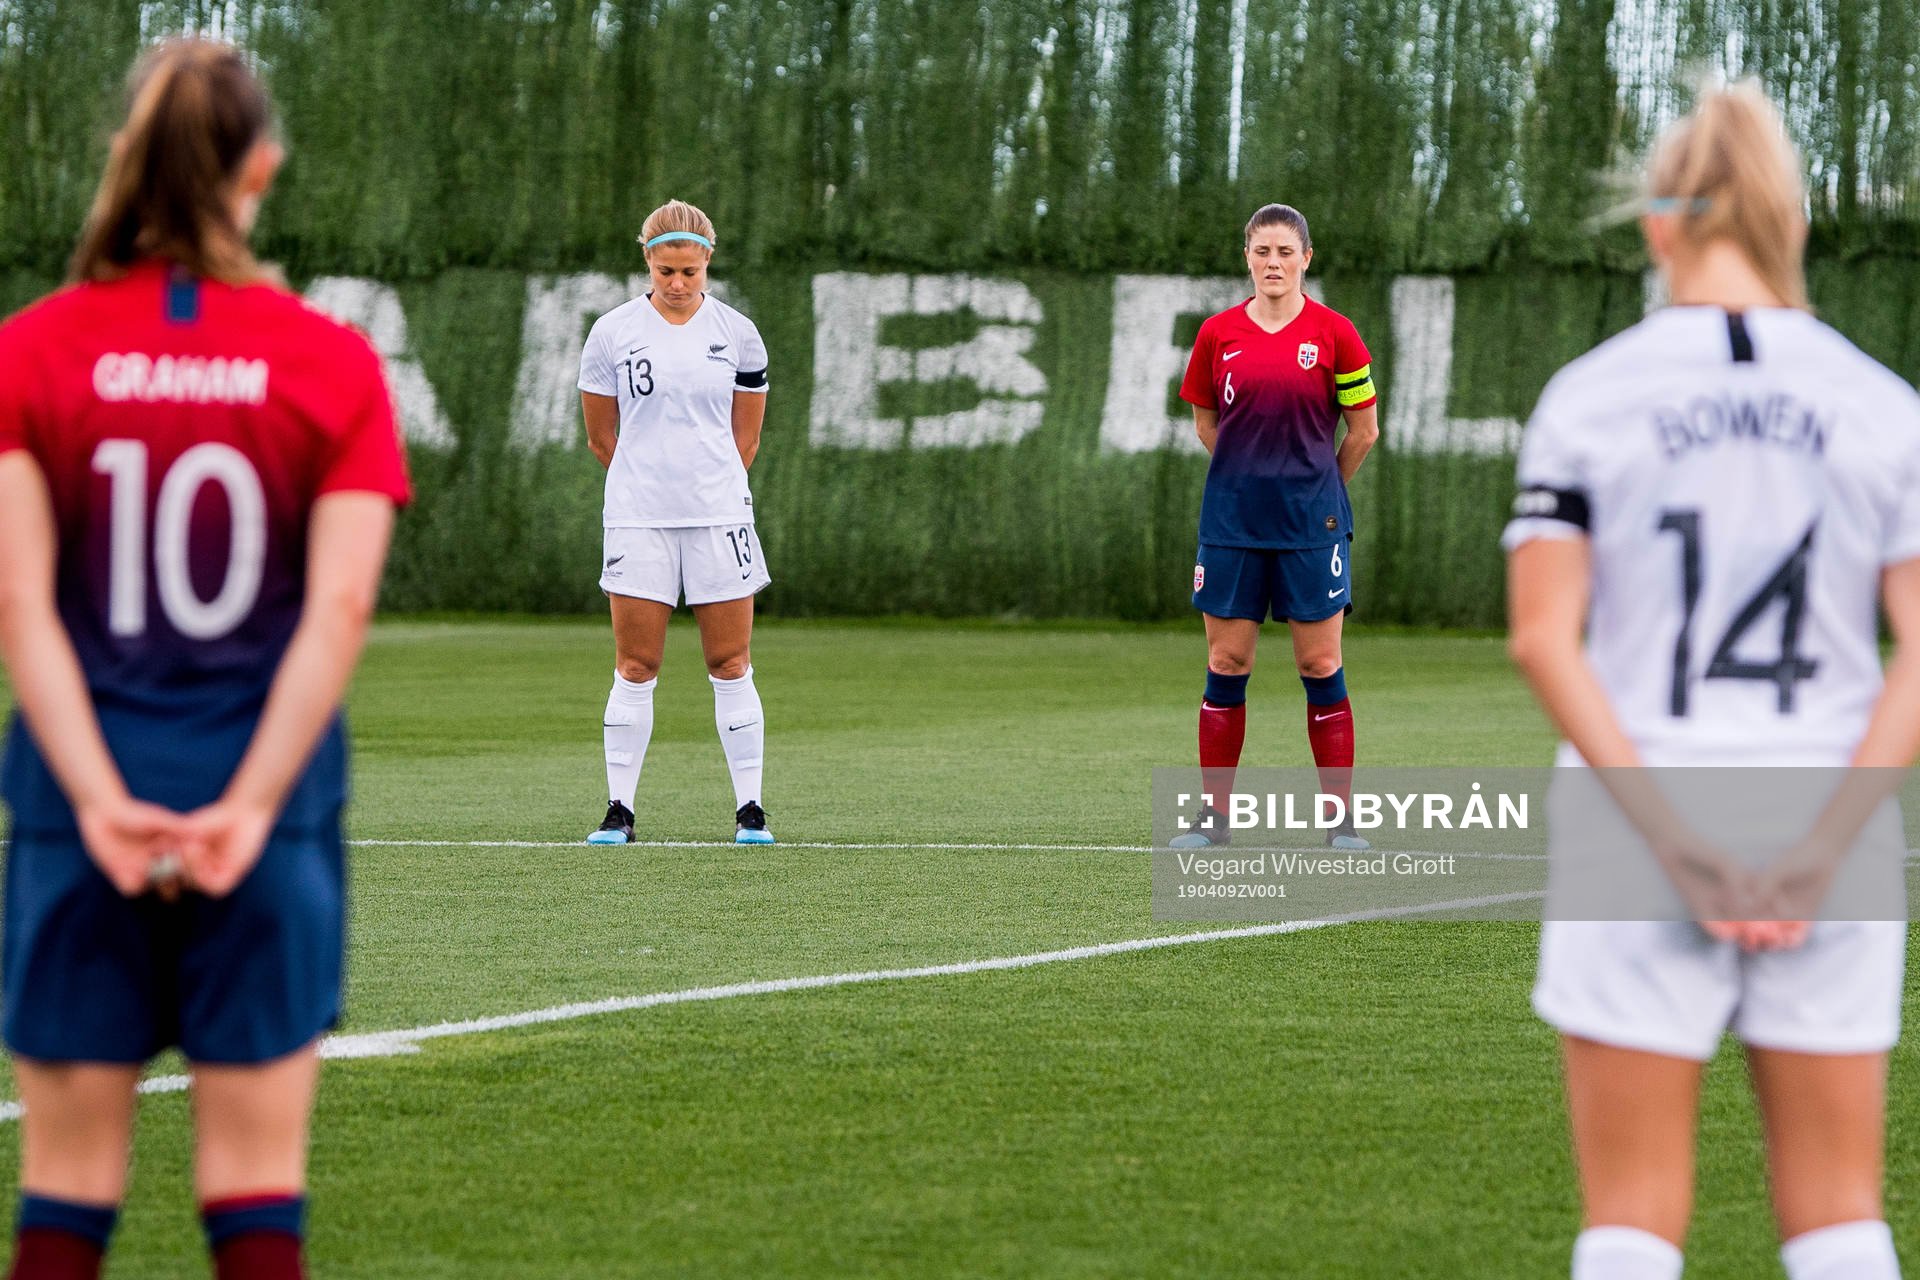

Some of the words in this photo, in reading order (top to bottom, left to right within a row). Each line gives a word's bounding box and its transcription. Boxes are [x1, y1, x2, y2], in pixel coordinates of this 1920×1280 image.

[92, 351, 269, 405] GRAHAM
[625, 358, 654, 398] 13
[1224, 372, 1235, 405] 6
[1652, 390, 1834, 462] BOWEN
[91, 437, 268, 641] 10
[726, 527, 752, 567] 13
[1330, 543, 1343, 577] 6
[1658, 511, 1820, 717] 14
